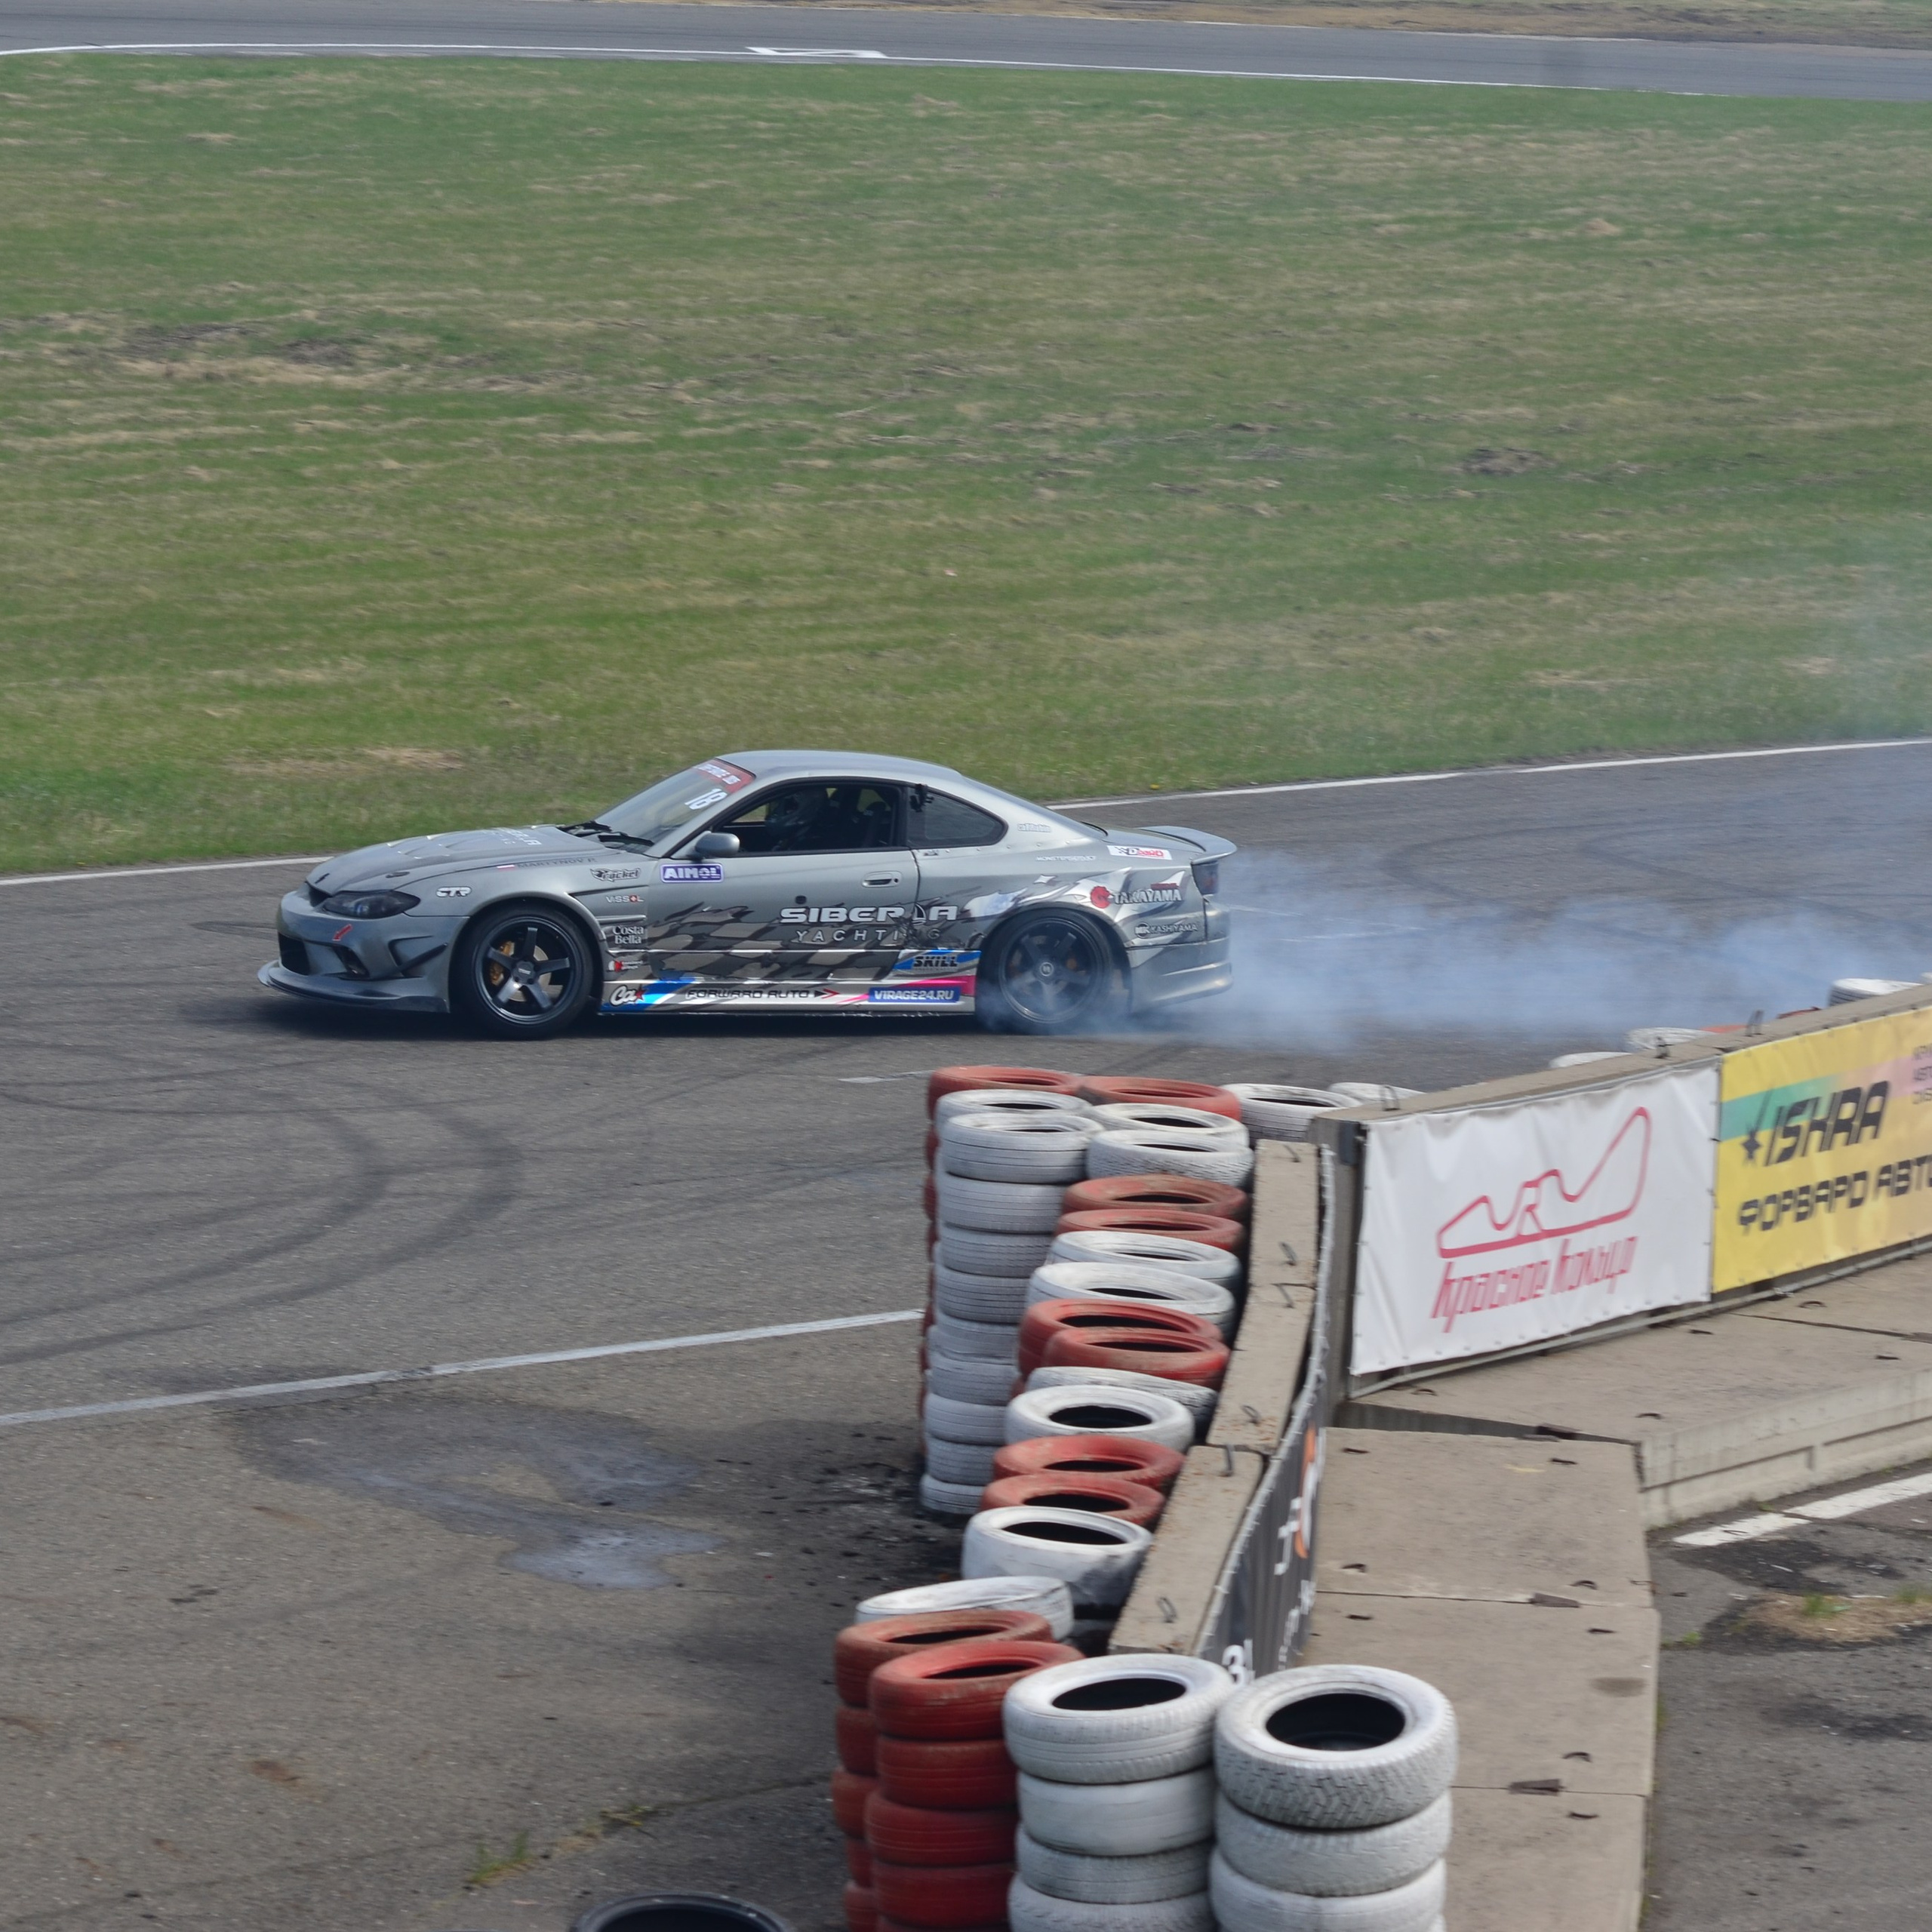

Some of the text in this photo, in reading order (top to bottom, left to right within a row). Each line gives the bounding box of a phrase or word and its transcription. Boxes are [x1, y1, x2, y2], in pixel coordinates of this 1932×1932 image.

[663, 867, 721, 880] AIMOL
[1113, 888, 1183, 905] TAKAYAMA
[612, 925, 645, 936] Costa
[795, 928, 941, 943] YACHTIG
[614, 934, 641, 944] Bella
[913, 955, 958, 968] SKILL
[686, 989, 811, 999] FORWARD AUTO
[874, 989, 955, 1001] VIRAGE24.RU
